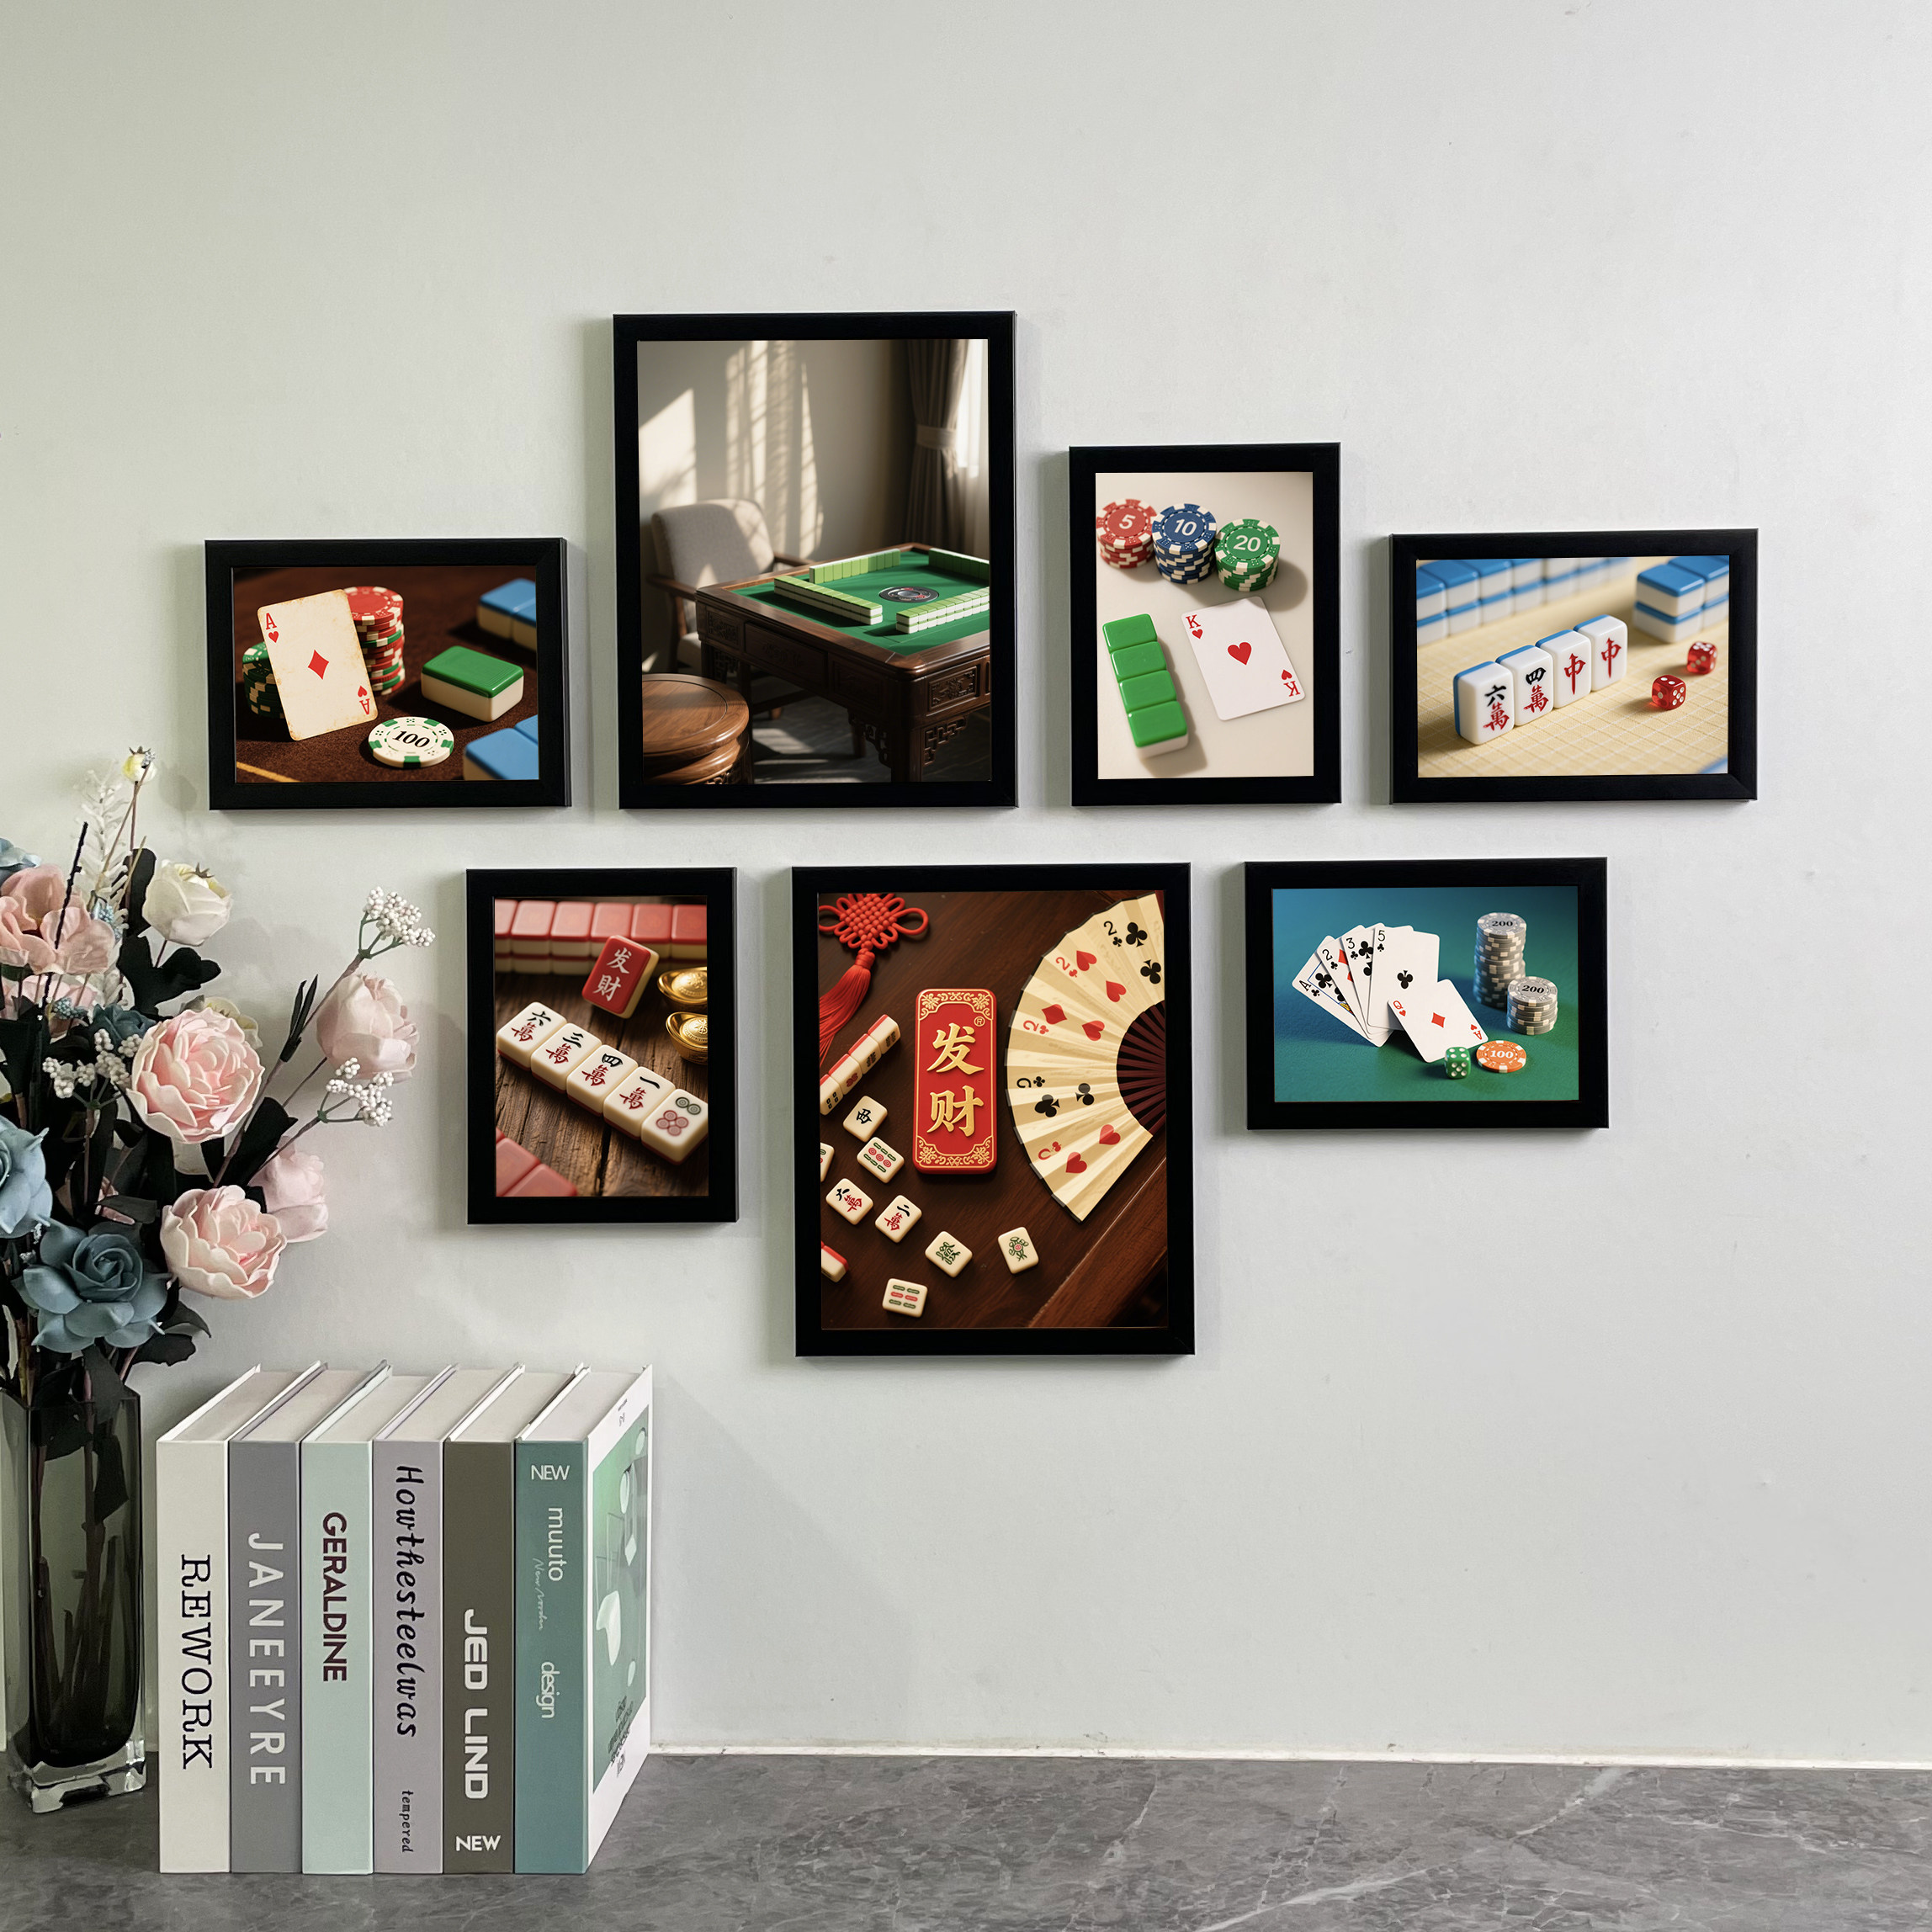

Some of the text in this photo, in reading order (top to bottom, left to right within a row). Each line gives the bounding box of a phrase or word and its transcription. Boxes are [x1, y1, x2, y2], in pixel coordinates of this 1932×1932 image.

[1119, 515, 1135, 528] 5
[1175, 519, 1197, 535] 10
[1234, 535, 1261, 552] 20
[266, 613, 277, 629] A
[1185, 614, 1202, 629] K
[1601, 638, 1622, 677] 中
[1564, 653, 1585, 694] 中
[1284, 681, 1300, 697] K
[359, 698, 369, 714] A
[395, 731, 430, 747] 100
[1104, 921, 1117, 936] 2
[1378, 930, 1385, 941] 5
[1346, 937, 1355, 949] 3
[1323, 949, 1332, 960] 2
[1056, 957, 1070, 970] 2
[1298, 979, 1312, 991] A
[1521, 985, 1545, 994] 200
[1393, 1000, 1404, 1010] Q
[1490, 1049, 1514, 1059] 100
[926, 1022, 985, 1137] 发财
[532, 1465, 570, 1480] NEW
[549, 1508, 566, 1581] muuto
[323, 1513, 347, 1681] GERALDINE
[182, 1554, 212, 1769] REWORK
[249, 1533, 285, 1784] JANEEYRE
[536, 1662, 560, 1717] design
[464, 1609, 487, 1798] JED LIND
[400, 1790, 414, 1853] tempered
[456, 1836, 501, 1850] NEW
